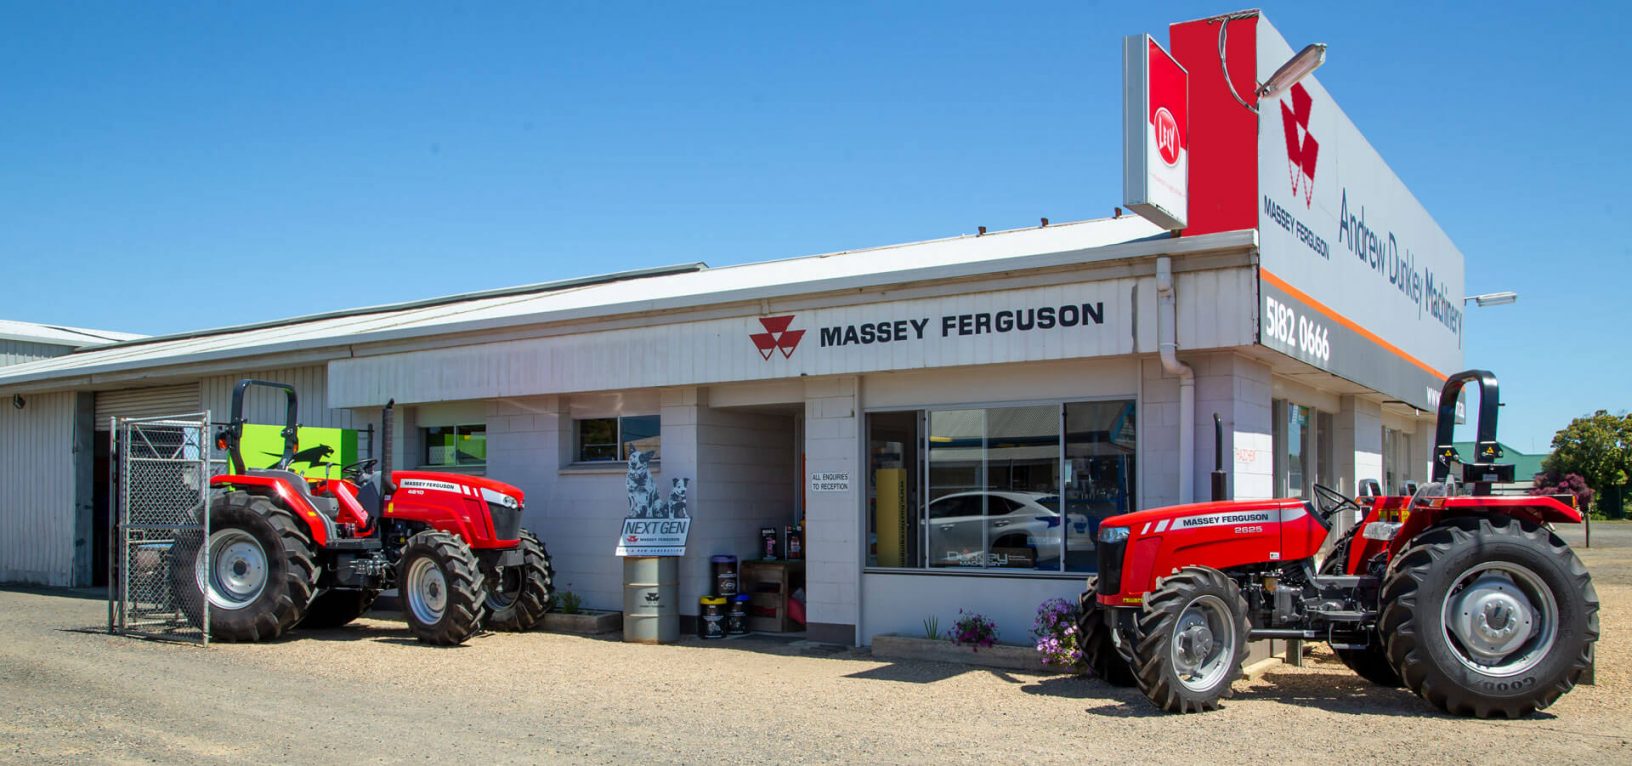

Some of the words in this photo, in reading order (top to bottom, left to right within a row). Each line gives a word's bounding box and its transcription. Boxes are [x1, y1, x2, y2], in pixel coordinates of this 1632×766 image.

[1159, 115, 1176, 159] LELY
[1264, 194, 1295, 236] MASSEY
[1296, 220, 1330, 261] FERGUSON
[1338, 187, 1386, 276] Andrew
[1388, 231, 1423, 321] Dunkley
[1425, 266, 1463, 350] Machinery
[820, 318, 930, 348] MASSEY
[941, 302, 1105, 338] FERGUSON
[1266, 295, 1296, 347] 5182
[1299, 314, 1330, 361] 0666
[426, 482, 455, 490] FERGUSON
[812, 473, 821, 481] ALL
[822, 473, 849, 481] ENQUIRIES
[625, 521, 661, 534] NEXT
[660, 521, 687, 534] GEN
[1183, 516, 1220, 527] MASSEY
[1222, 513, 1269, 523] FERGUSON
[1234, 525, 1263, 534] 2625
